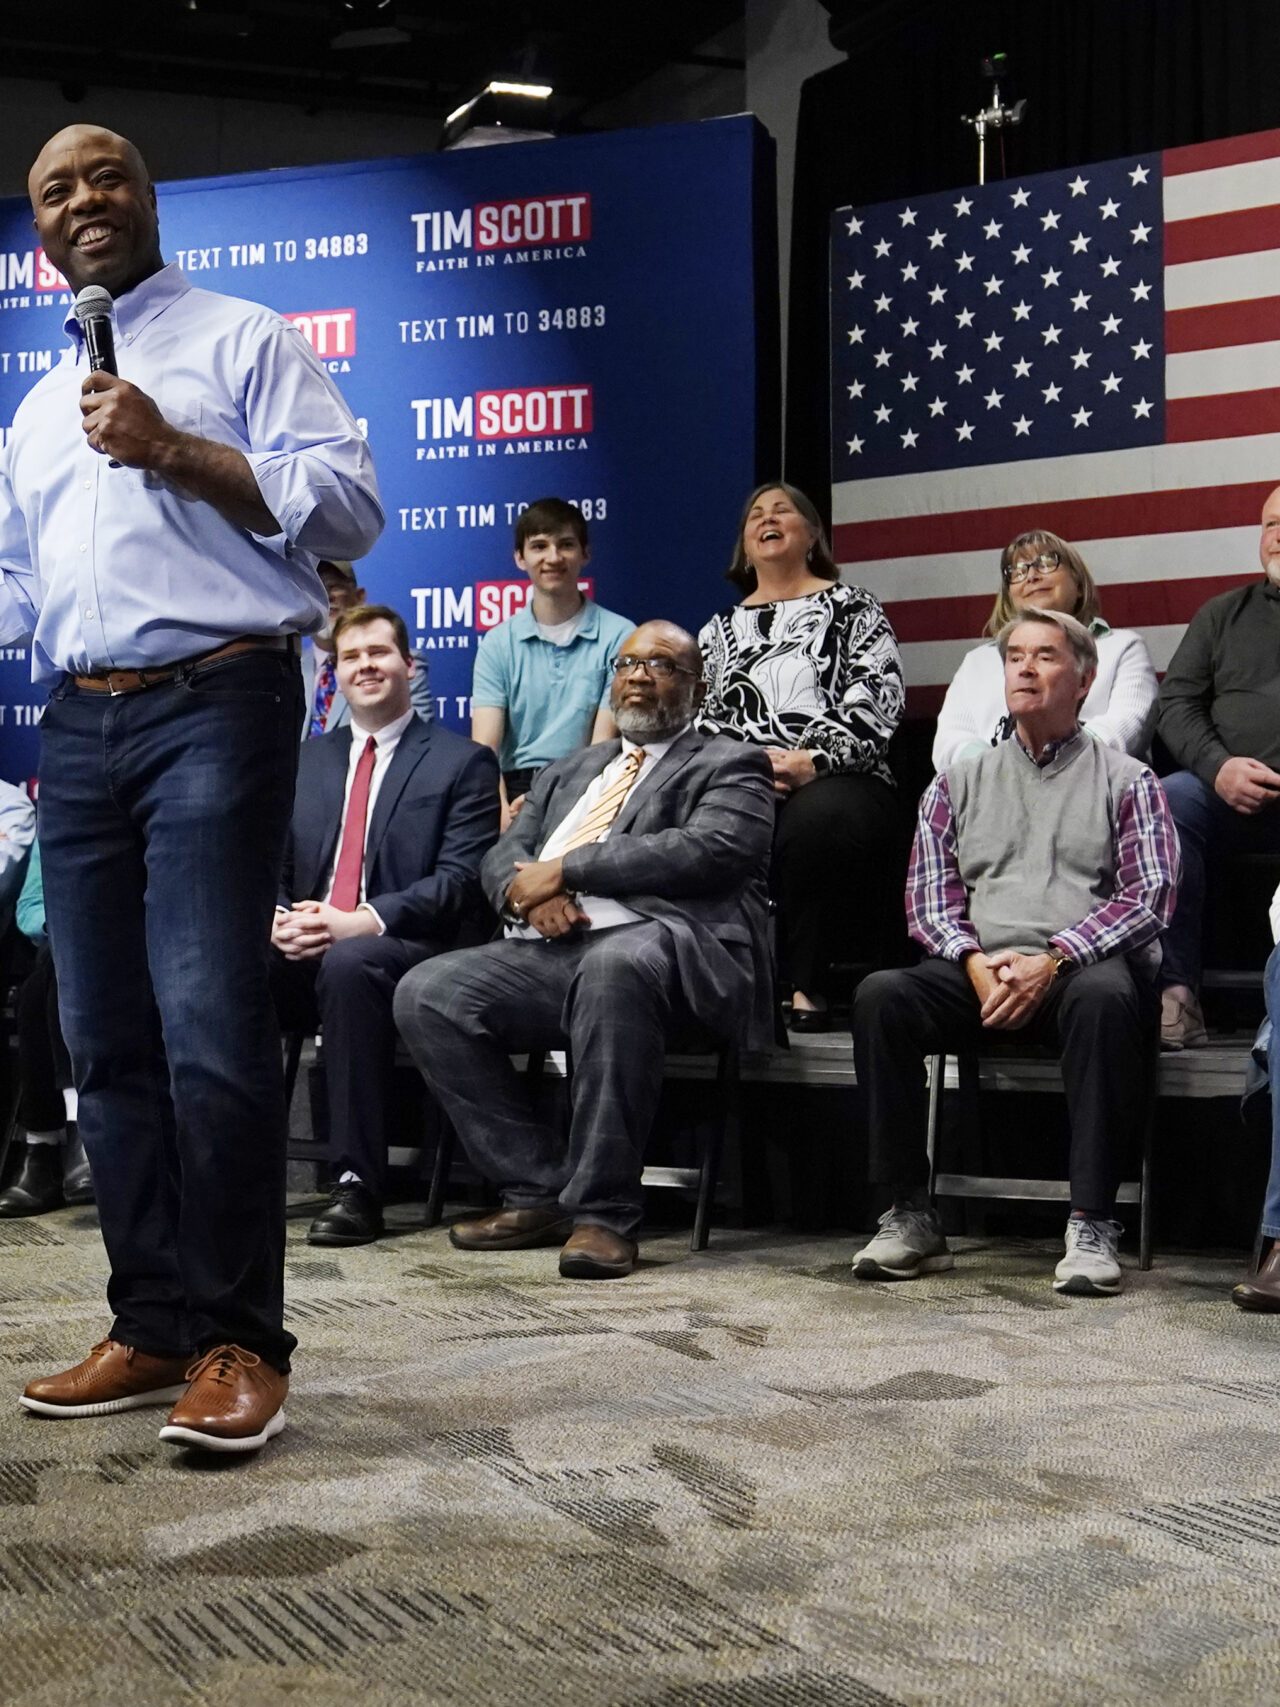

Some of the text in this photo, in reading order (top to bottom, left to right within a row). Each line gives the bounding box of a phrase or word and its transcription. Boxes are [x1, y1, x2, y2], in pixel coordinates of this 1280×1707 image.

[410, 197, 587, 254] TIM SCOTT
[176, 232, 369, 271] TEXT TIM TO 34883
[415, 245, 587, 273] FAITH IN AMERICA
[36, 294, 54, 307] IN
[398, 304, 606, 344] TEXT TIM TO 34883
[17, 350, 52, 373] TIM
[410, 395, 473, 441] TIM
[478, 388, 589, 435] SCOTT
[416, 437, 588, 460] FAITH IN AMERICA
[398, 506, 449, 531] TEXT
[455, 504, 495, 529] TIM
[410, 586, 473, 630] TIM
[416, 635, 469, 649] FAITH
